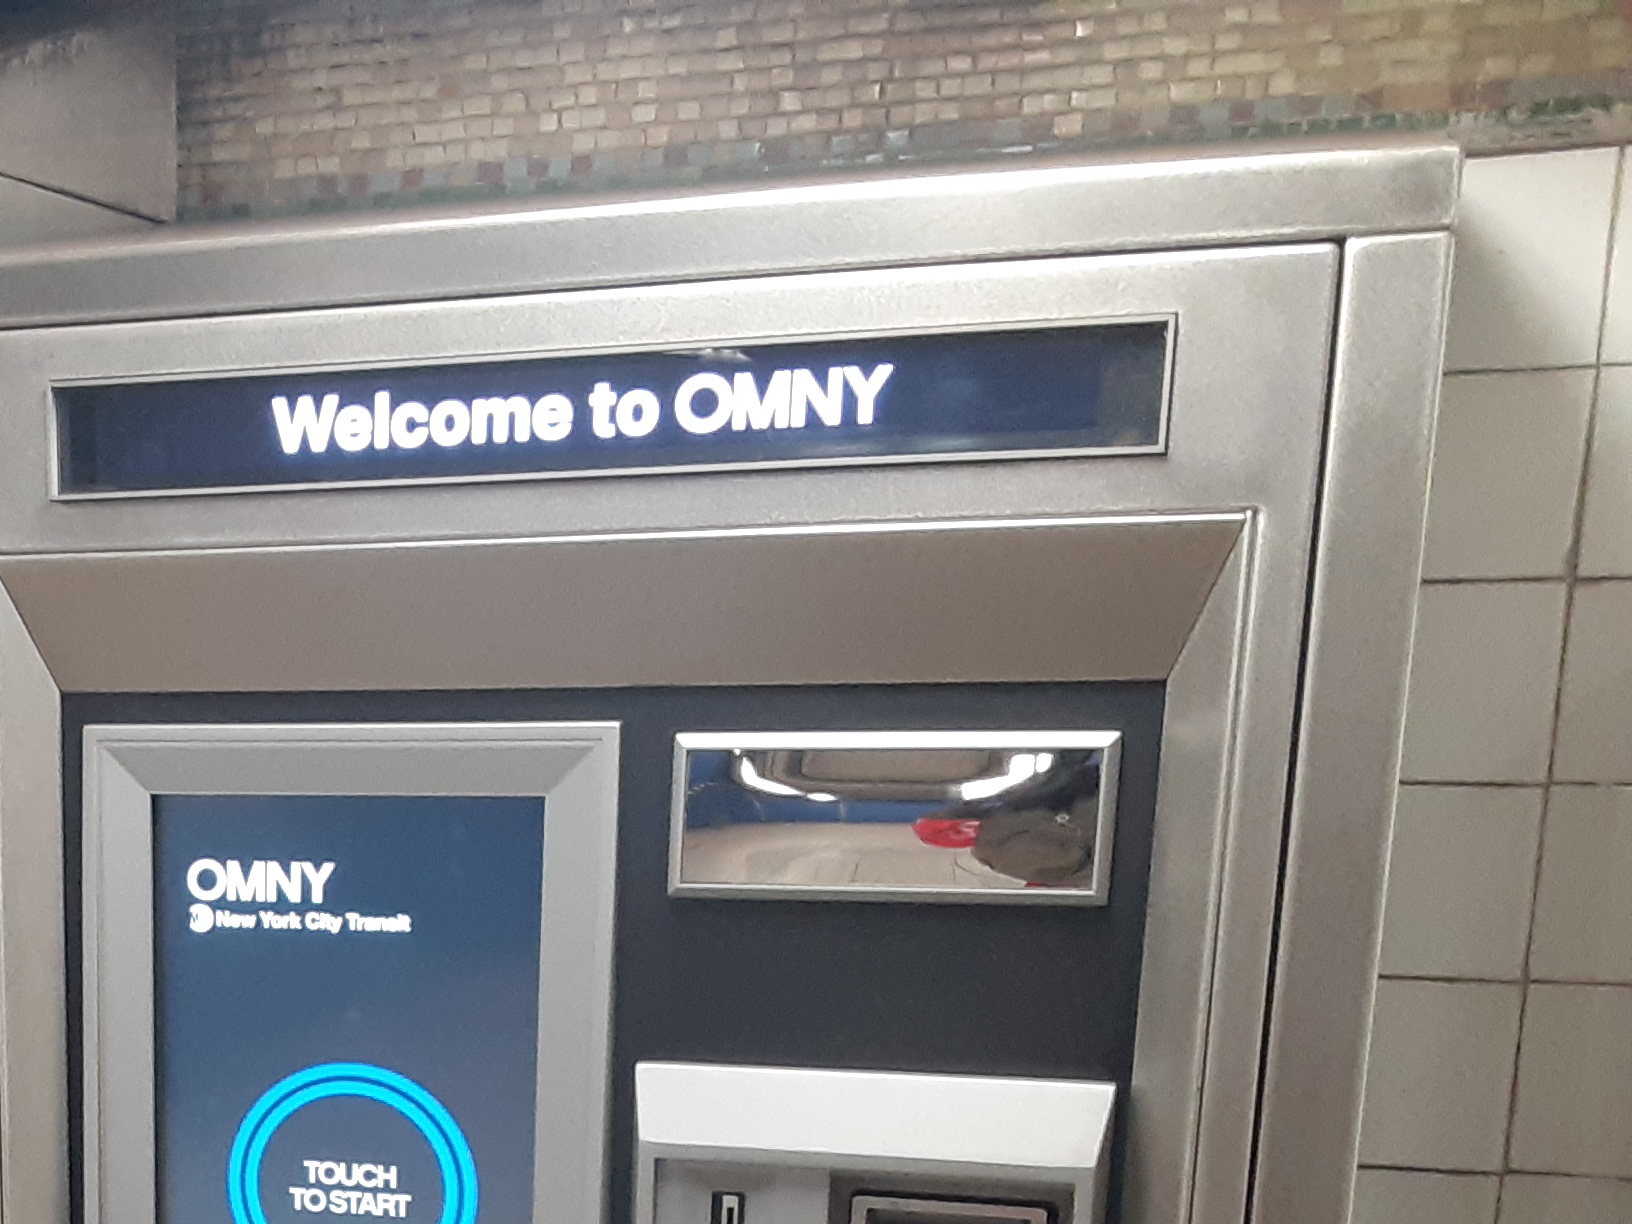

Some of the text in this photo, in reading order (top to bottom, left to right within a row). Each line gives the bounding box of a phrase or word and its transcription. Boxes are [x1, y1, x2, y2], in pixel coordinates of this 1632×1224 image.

[272, 364, 894, 454] Welcome to OMNY
[186, 858, 336, 903] OMNY
[215, 909, 257, 928] New
[259, 910, 302, 930] York
[305, 911, 343, 934] City
[346, 911, 413, 933] Transit
[302, 1159, 398, 1189] TOUCH
[288, 1186, 413, 1218] TO START
